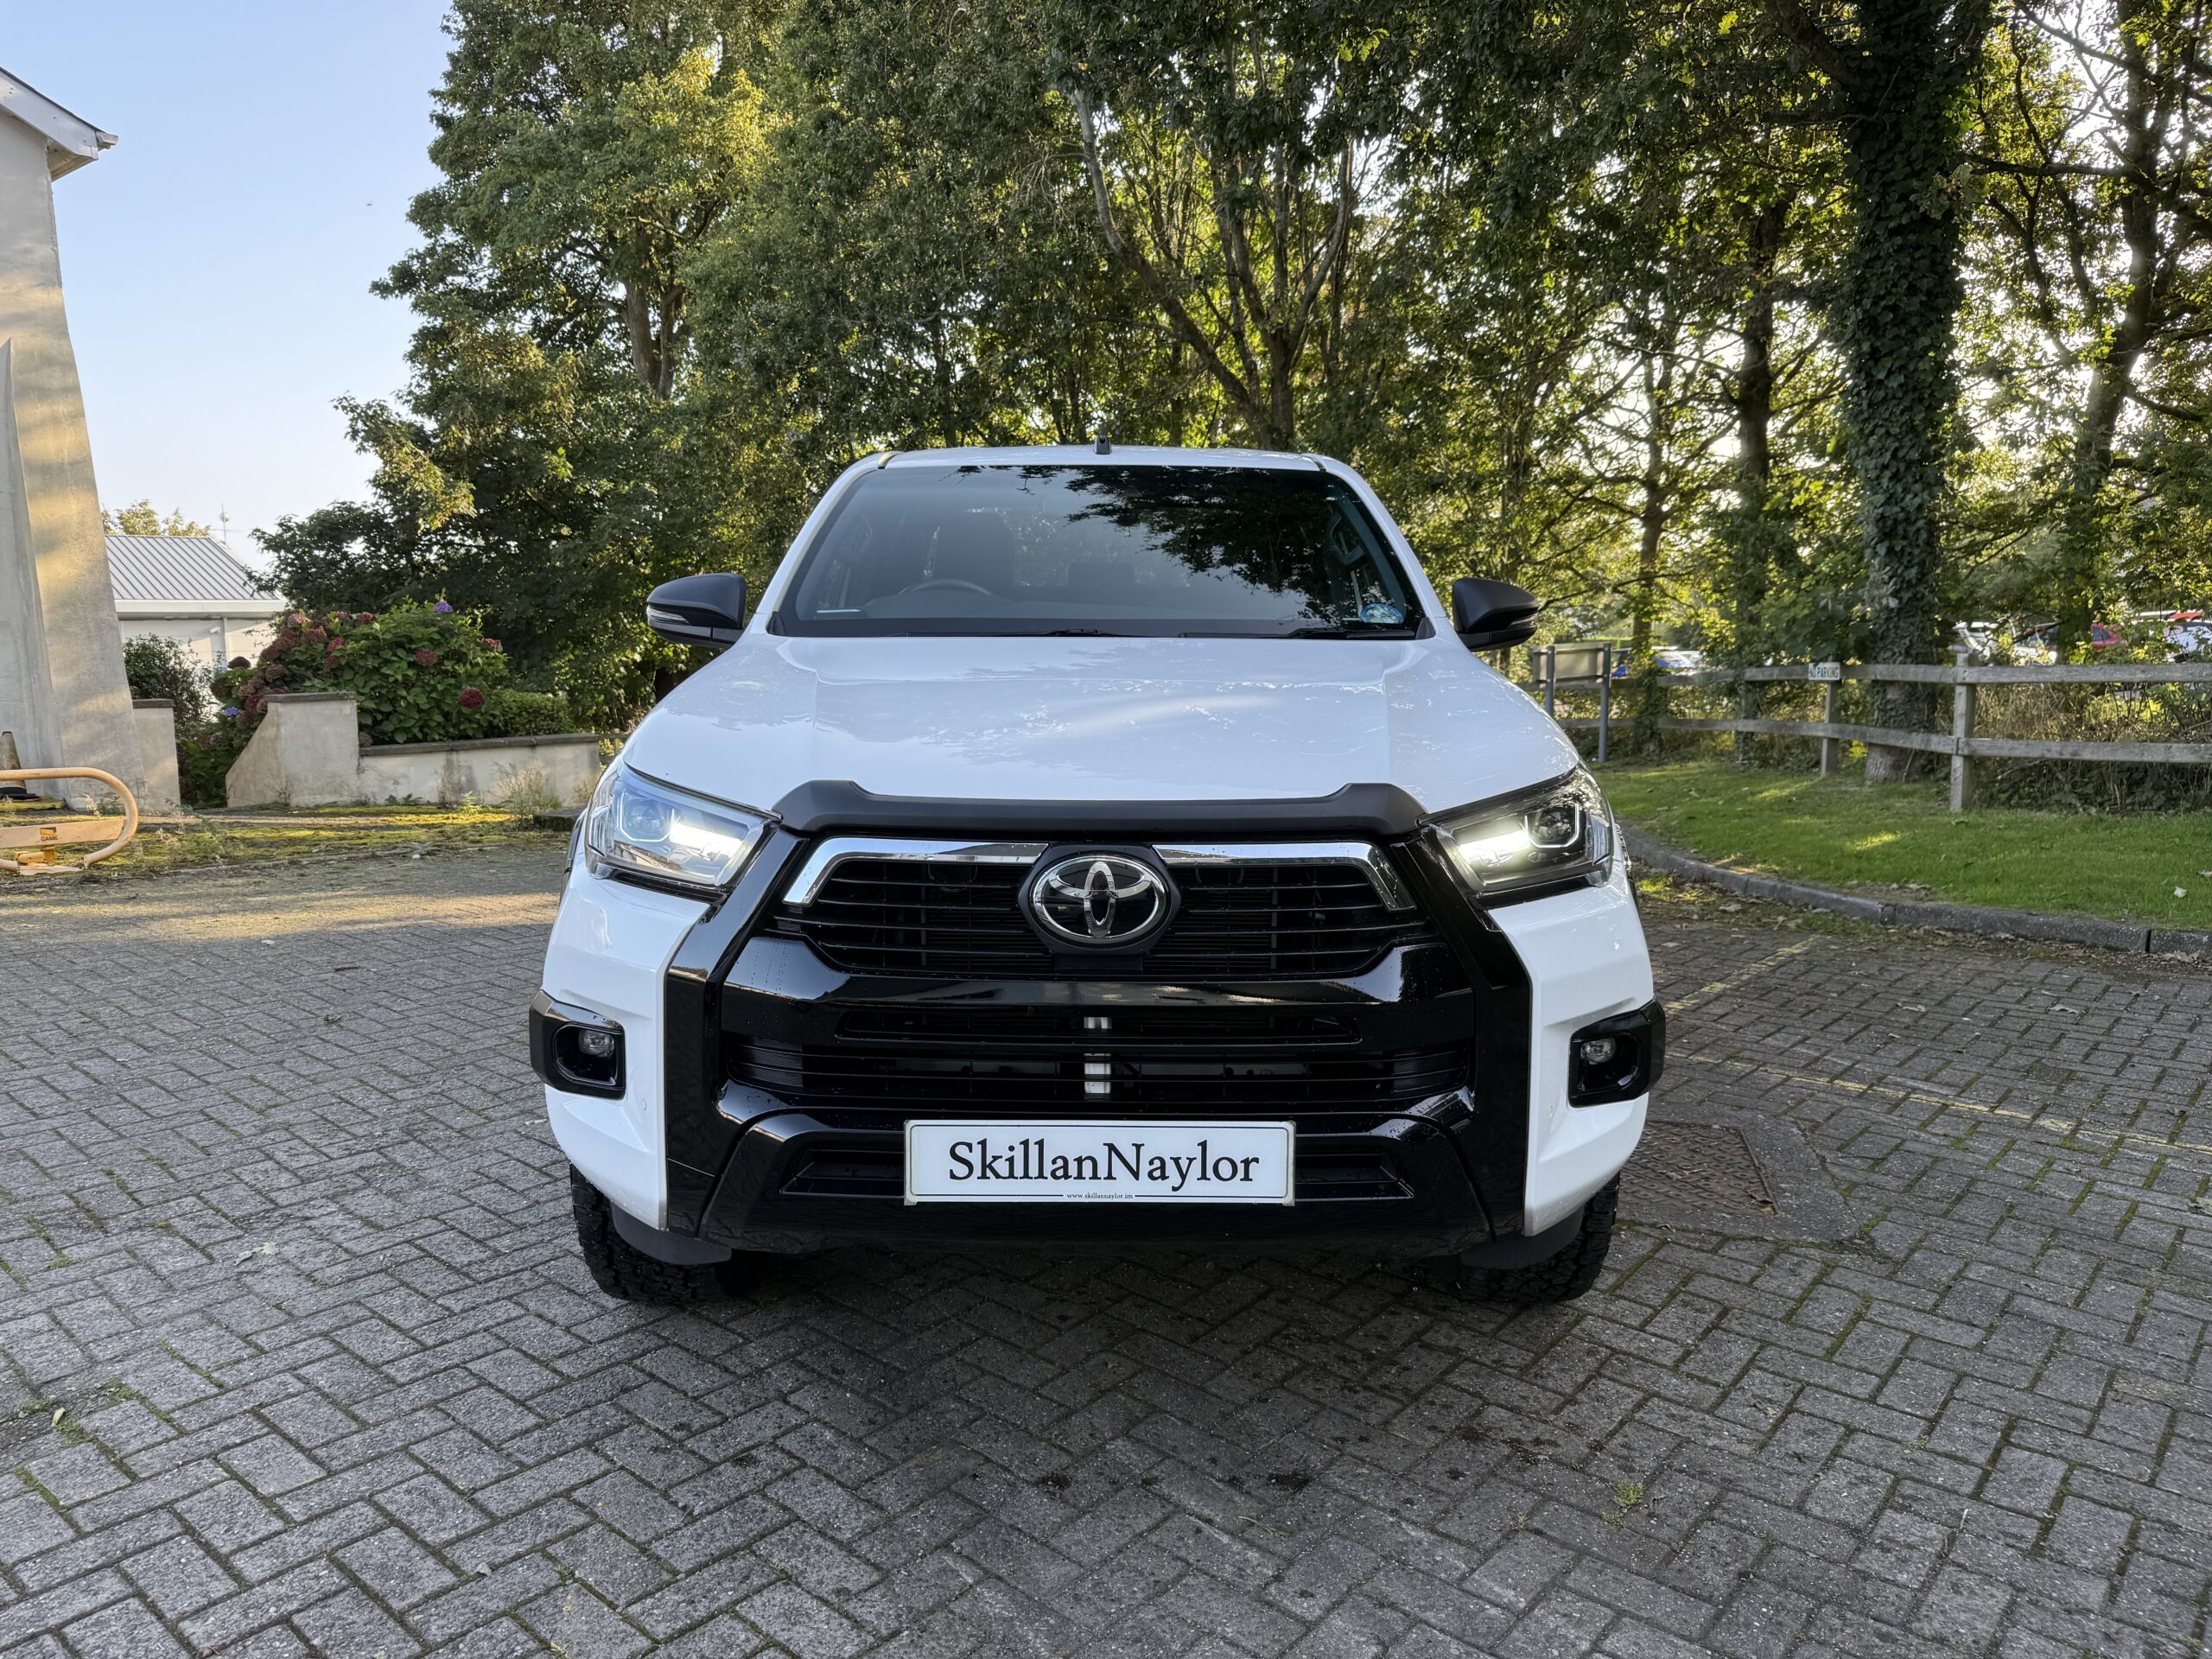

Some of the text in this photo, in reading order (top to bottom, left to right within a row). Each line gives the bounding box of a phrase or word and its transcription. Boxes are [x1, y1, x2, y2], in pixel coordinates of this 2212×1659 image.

[1817, 666, 1839, 678] PARKING
[949, 1138, 1260, 1192] SkillanNaylor
[1066, 1192, 1134, 1200] www.skillannaylor.im
